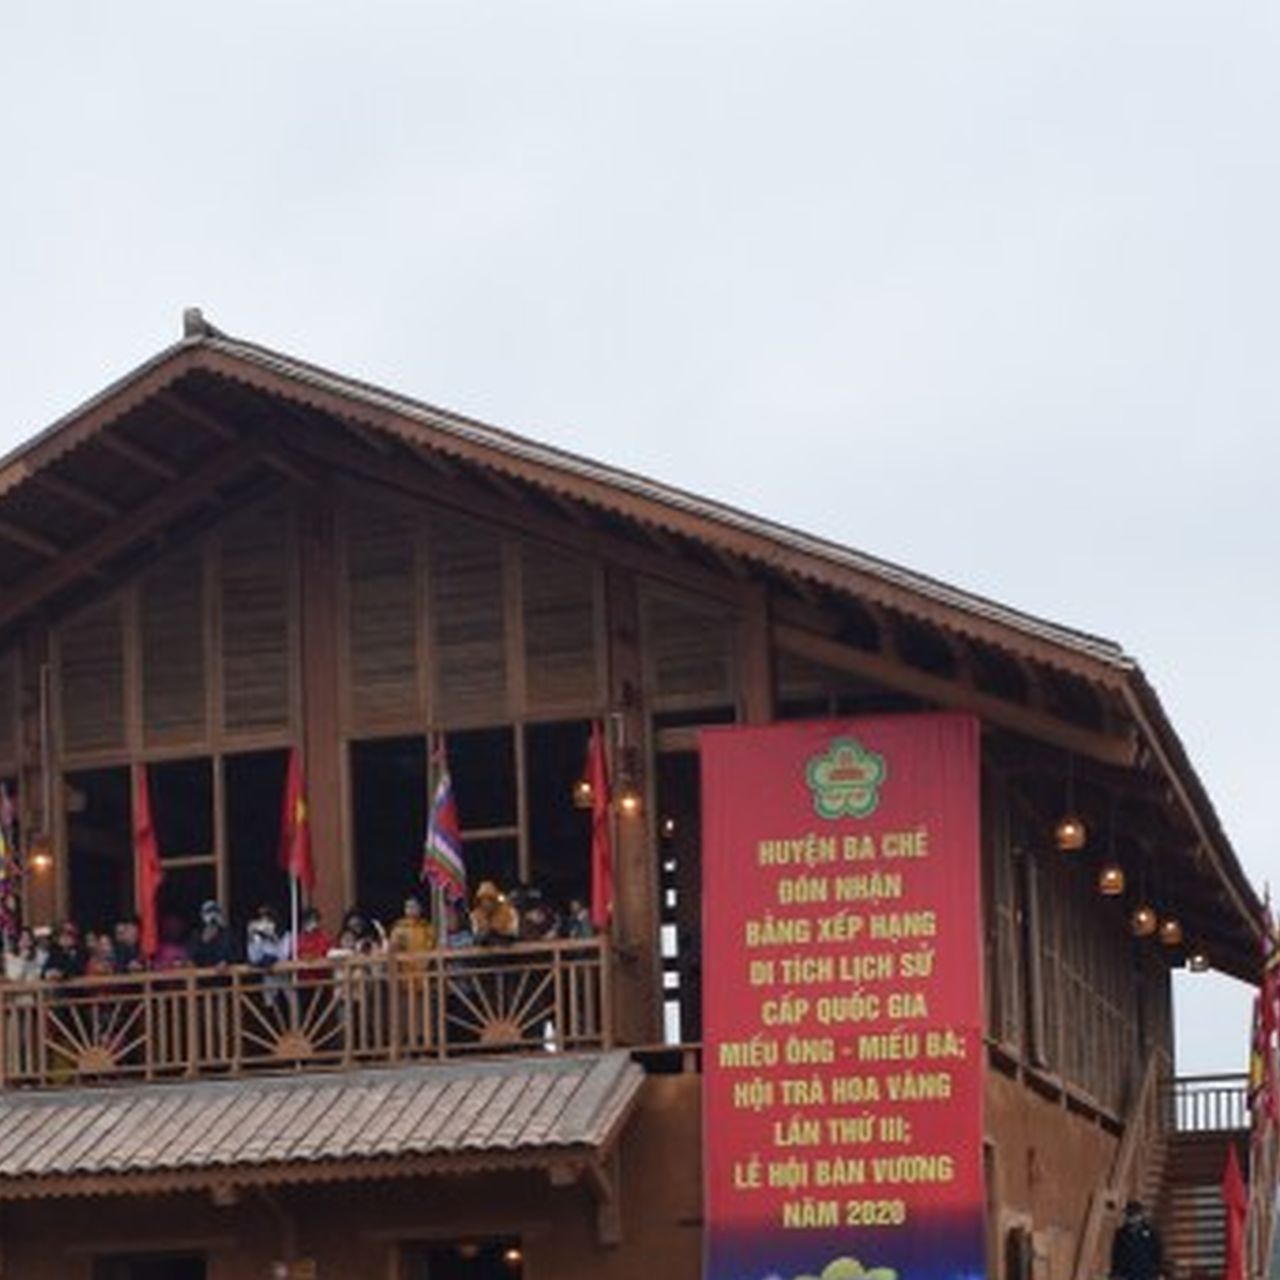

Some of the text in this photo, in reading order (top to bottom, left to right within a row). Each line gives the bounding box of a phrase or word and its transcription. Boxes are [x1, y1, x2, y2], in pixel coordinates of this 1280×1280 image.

[844, 835, 875, 862] BA
[750, 960, 774, 985] DI
[888, 993, 928, 1019] GIA
[831, 1077, 880, 1103] HOA
[846, 1200, 907, 1226] 2020
